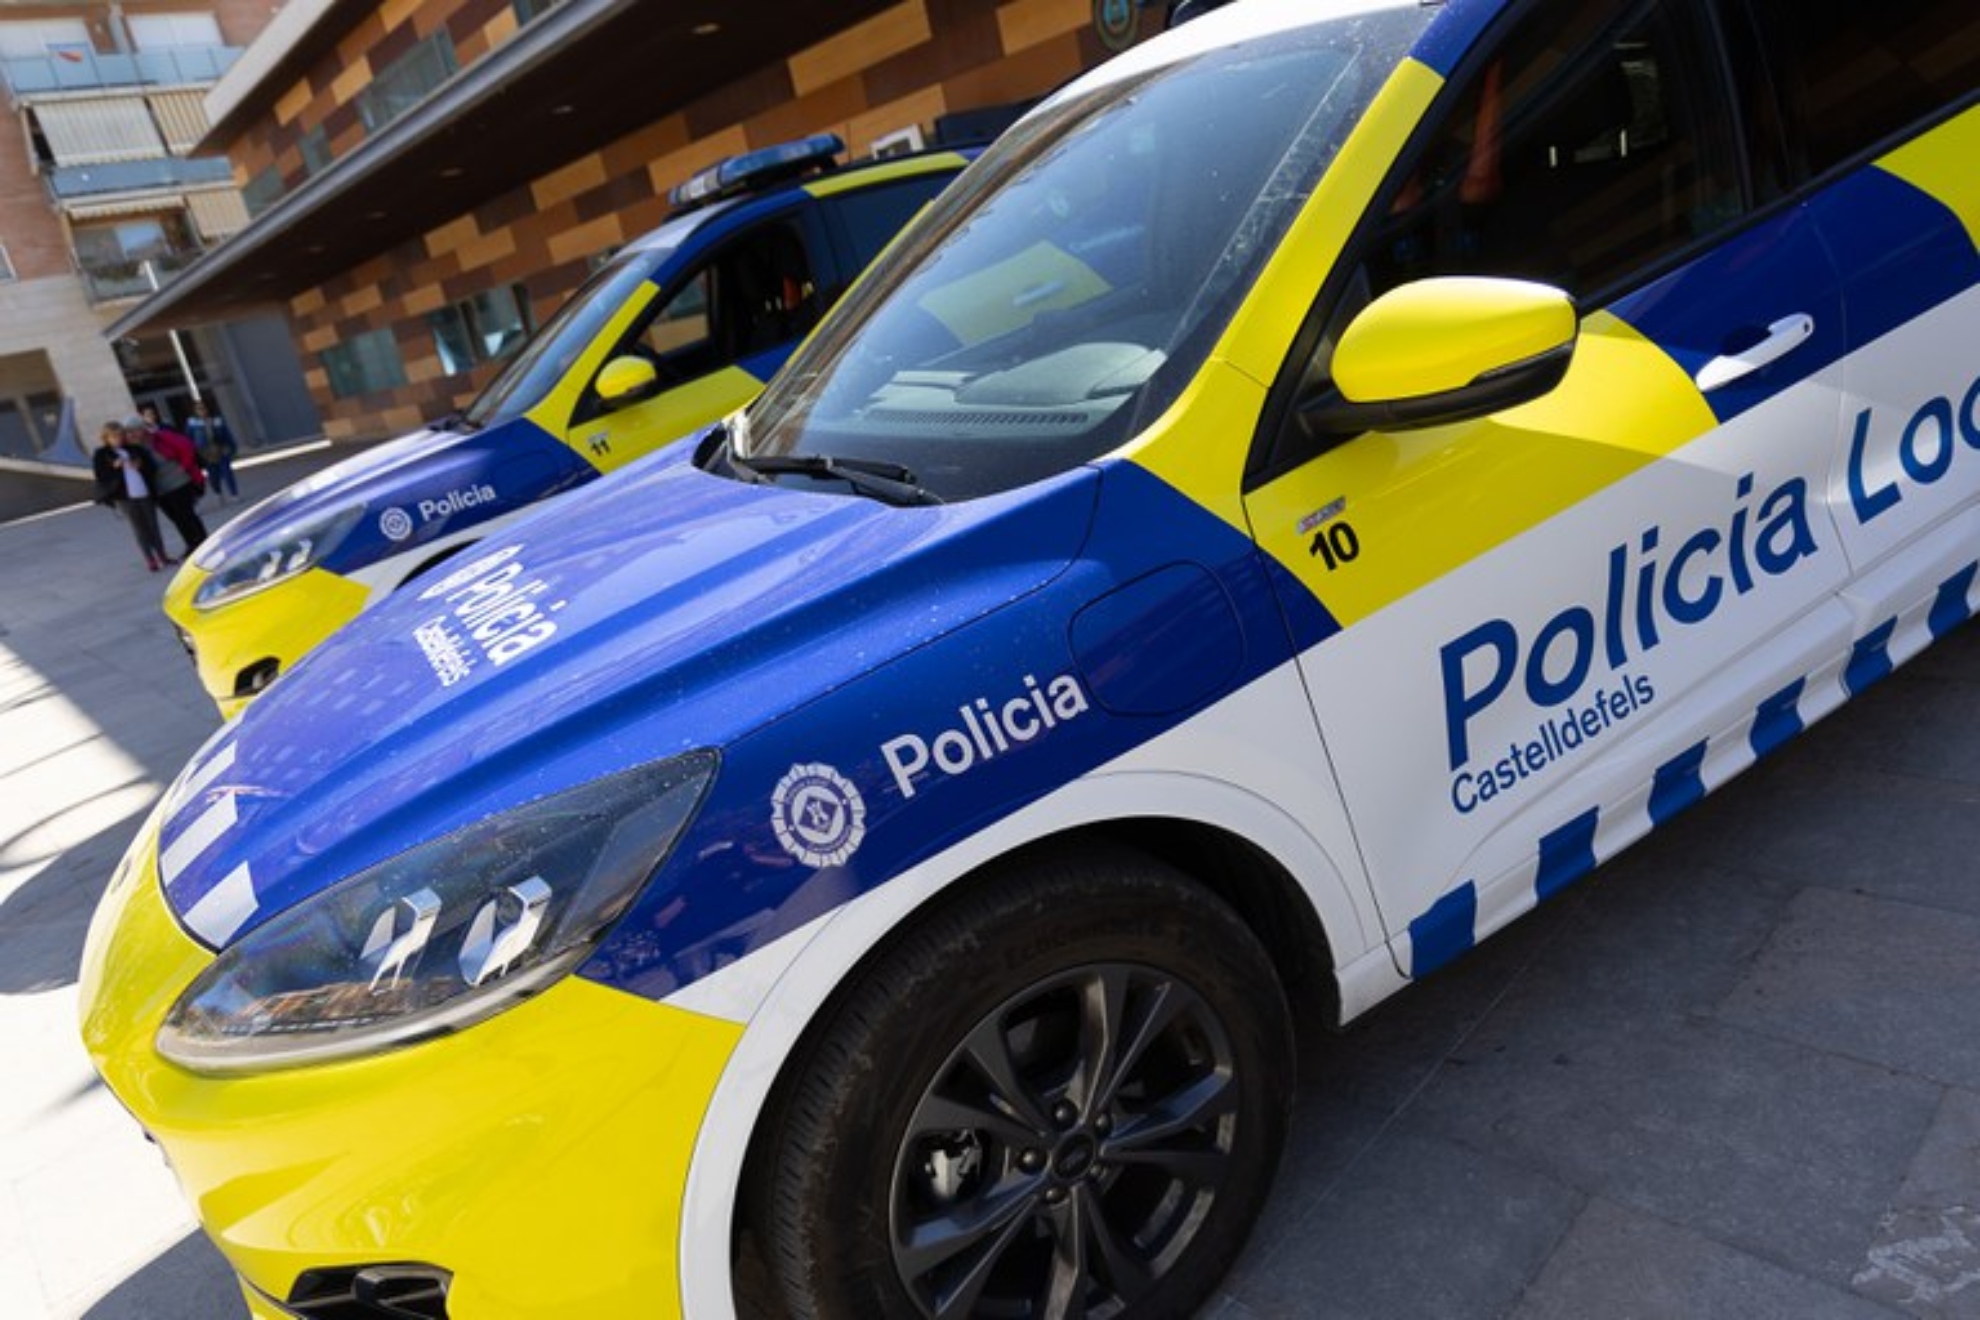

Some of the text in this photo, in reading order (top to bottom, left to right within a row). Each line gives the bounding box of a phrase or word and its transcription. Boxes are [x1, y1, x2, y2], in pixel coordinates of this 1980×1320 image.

[418, 484, 497, 521] Policia
[1309, 521, 1360, 571] 10
[446, 562, 567, 667] Policia
[1438, 471, 1818, 772] Policia
[880, 674, 1089, 798] Policia
[1450, 672, 1656, 814] Castelldefels
